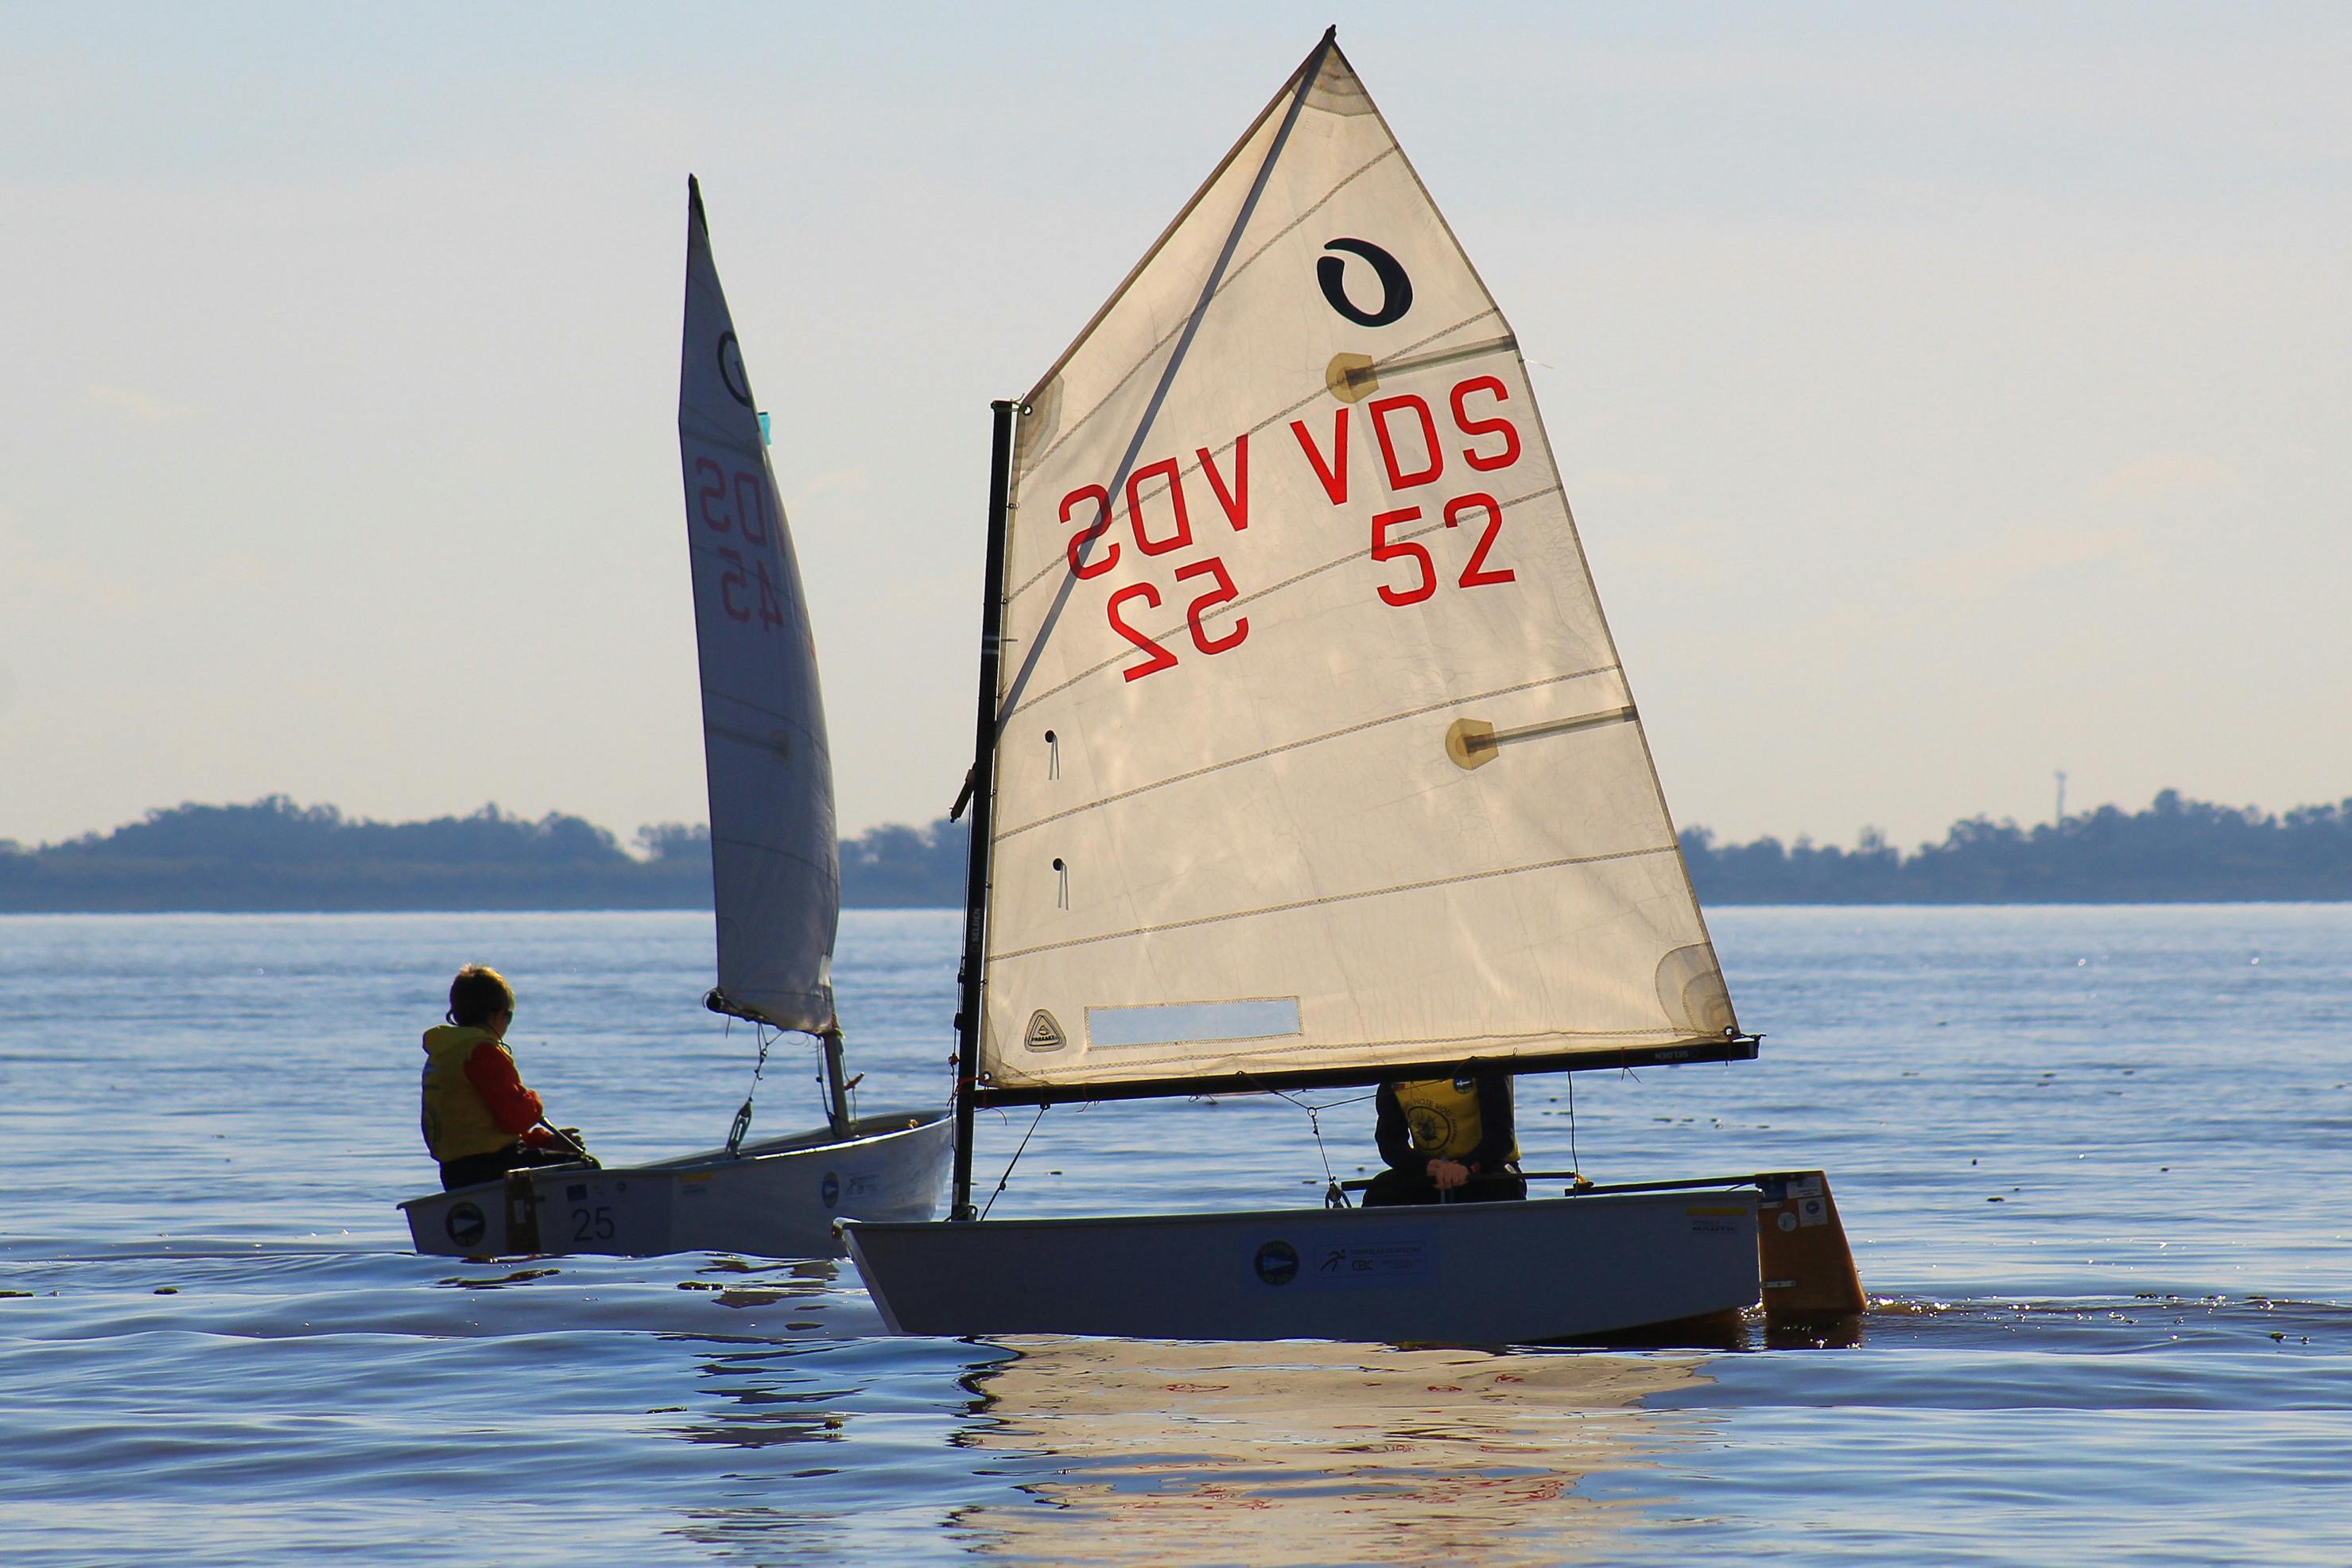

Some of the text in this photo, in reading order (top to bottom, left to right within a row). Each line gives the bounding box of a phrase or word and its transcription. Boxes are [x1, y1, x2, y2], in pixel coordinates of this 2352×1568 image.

[1290, 375, 1521, 505] VDS
[1372, 492, 1516, 607] 52
[572, 1206, 615, 1242] 25
